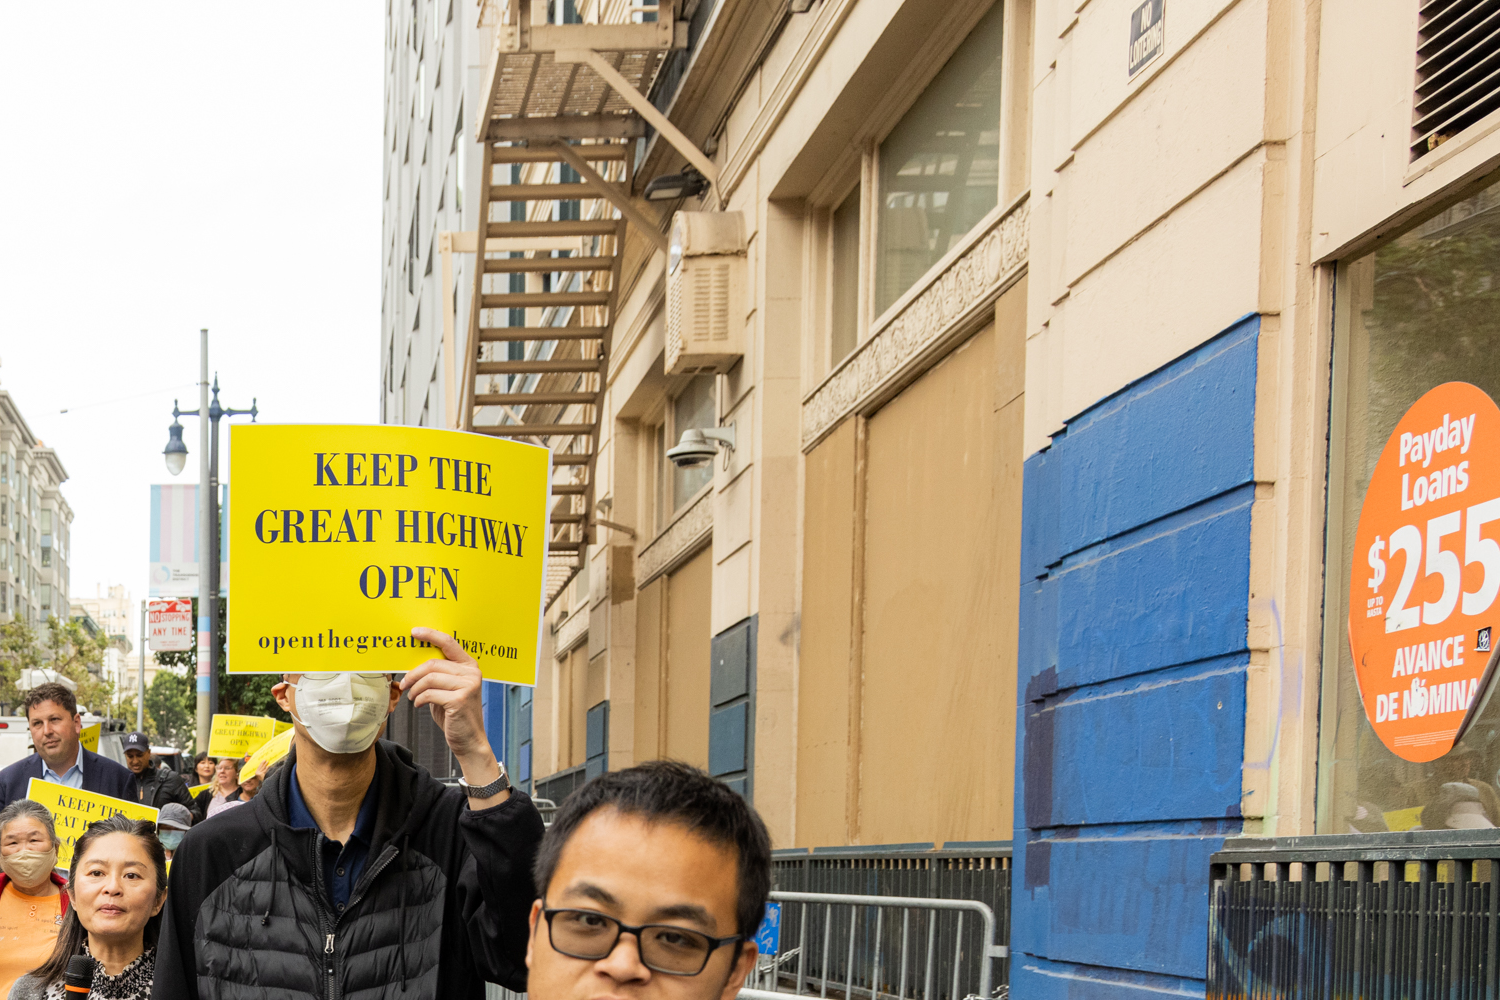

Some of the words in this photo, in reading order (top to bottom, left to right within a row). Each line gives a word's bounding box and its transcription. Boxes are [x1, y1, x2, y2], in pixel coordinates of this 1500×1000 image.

[1141, 1, 1152, 33] NO
[1130, 20, 1162, 69] LOITERING
[1398, 412, 1476, 467] Payday
[313, 452, 418, 487] KEEP
[429, 456, 492, 497] THE
[1400, 460, 1470, 511] Loans
[254, 508, 382, 544] GREAT
[395, 509, 528, 558] HIGHWAY
[358, 564, 460, 602] OPEN
[150, 612, 160, 623] NO
[161, 612, 190, 622] STOPPING
[1367, 597, 1376, 608] UP
[1376, 595, 1384, 606] TO
[152, 627, 167, 636] ANY
[171, 626, 187, 636] TIME
[1391, 634, 1465, 678] AVANCE
[225, 719, 244, 727] KEEP
[245, 720, 260, 728] THE
[1375, 691, 1399, 724] DE
[214, 728, 236, 736] GREAT
[237, 729, 269, 739] HIGHWAY
[230, 738, 250, 746] OPEN
[57, 794, 96, 814] KEEP
[53, 812, 80, 830] EAT
